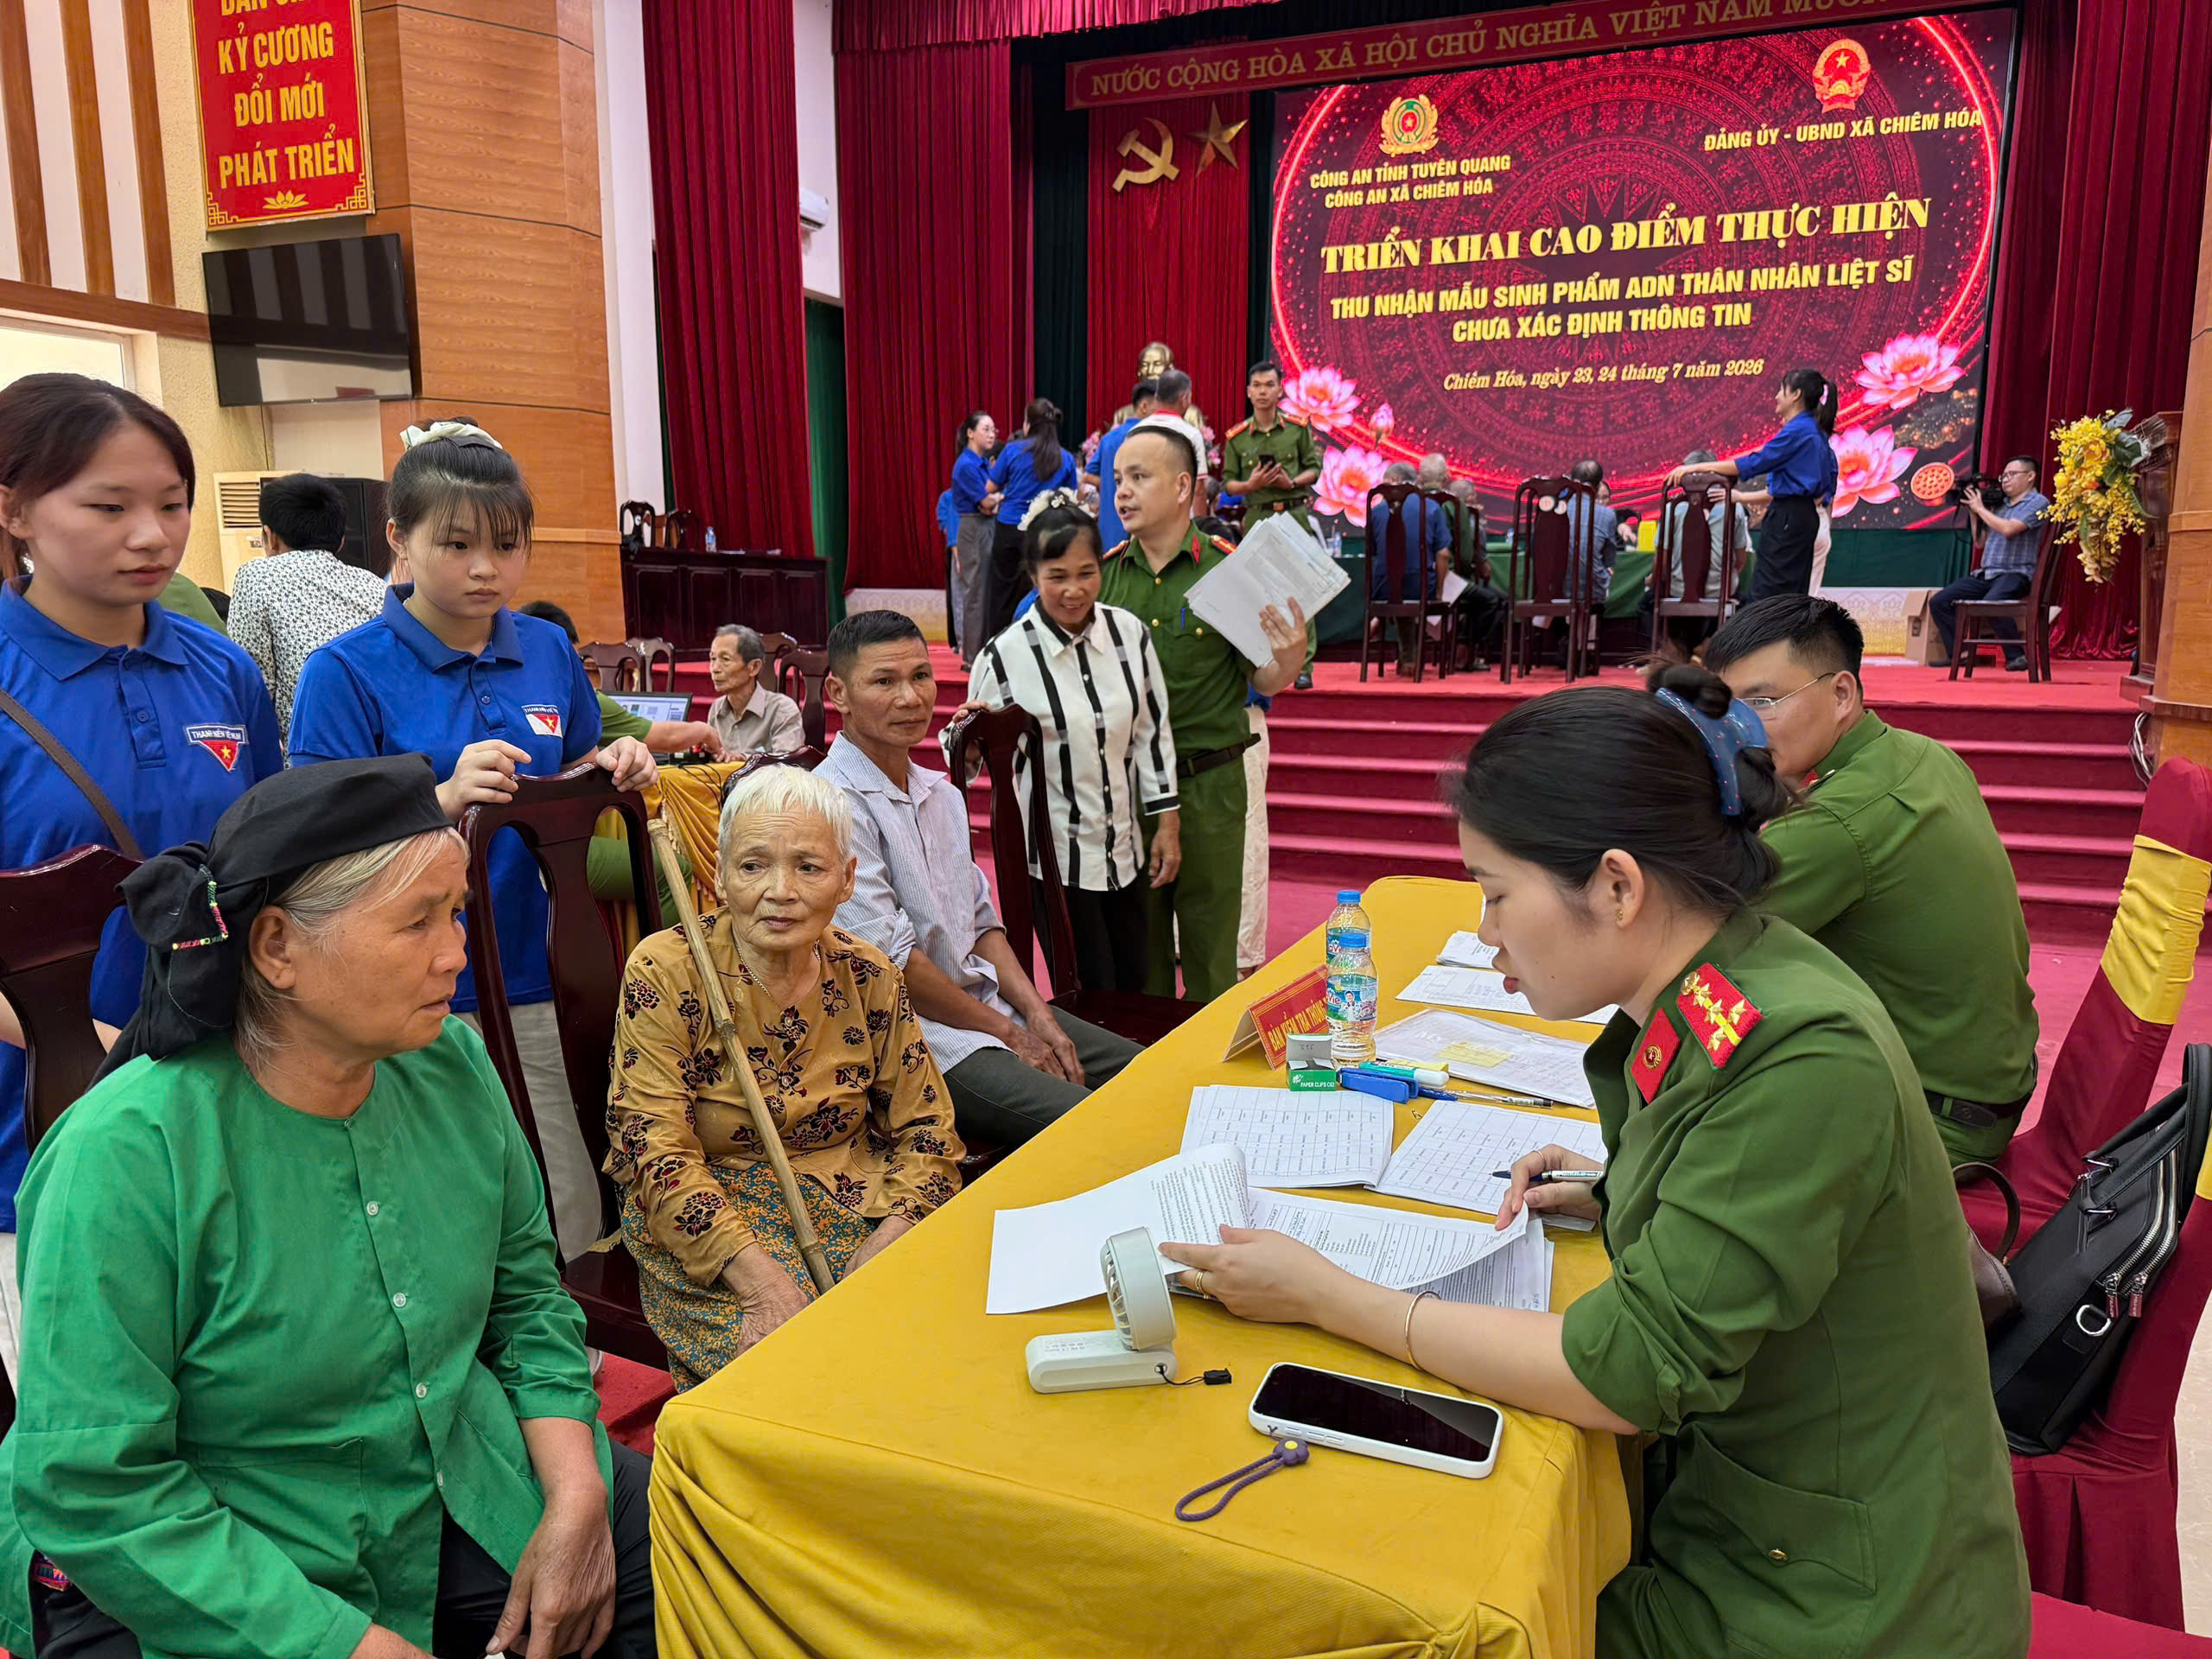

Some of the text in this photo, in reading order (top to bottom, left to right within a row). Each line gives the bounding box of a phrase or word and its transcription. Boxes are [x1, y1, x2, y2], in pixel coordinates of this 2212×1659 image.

[218, 22, 334, 74] KỶ CƯƠNG
[1090, 62, 1162, 96] NƯỚC
[1167, 57, 1240, 91] CỘNG
[1248, 47, 1306, 79] HÒA
[1314, 42, 1356, 71] XÃ
[1364, 34, 1417, 67] HỘI
[1427, 19, 1487, 58] CHỦ
[1496, 14, 1599, 50] NGHĨA
[1609, 0, 1686, 37] VIỆT
[1694, 0, 1773, 25] NAM
[234, 72, 325, 127] ĐỔI MỚI
[1704, 127, 1751, 151] ĐẢNG
[1756, 124, 1779, 146] ỦY
[1796, 122, 1845, 143] UBND
[1849, 116, 1875, 137] XÃ
[1879, 111, 1939, 135] CHIÊM
[1944, 107, 1982, 128] HÓA
[219, 124, 355, 189] PHÁT TRIỂN
[1310, 155, 1511, 188] CÔNG AN TỈNH TUYÊN QUANG
[1325, 176, 1493, 208] CÔNG AN XÃ CHIÊM HÓA
[1320, 192, 1931, 274] TRIỂN KHAI CAO ĐIỂM THỰC HIỆN
[1330, 254, 1915, 320] THU NHẬN MẪU SINH PHẨM ADN THÂN NHÂN LIỆT SĨ
[1452, 302, 1752, 342] CHƯA XÁC ĐỊNH THÔNG TIN
[1443, 359, 1764, 390] Chiêm Hóa, ngày 23, 24 tháng 7 năm 2026
